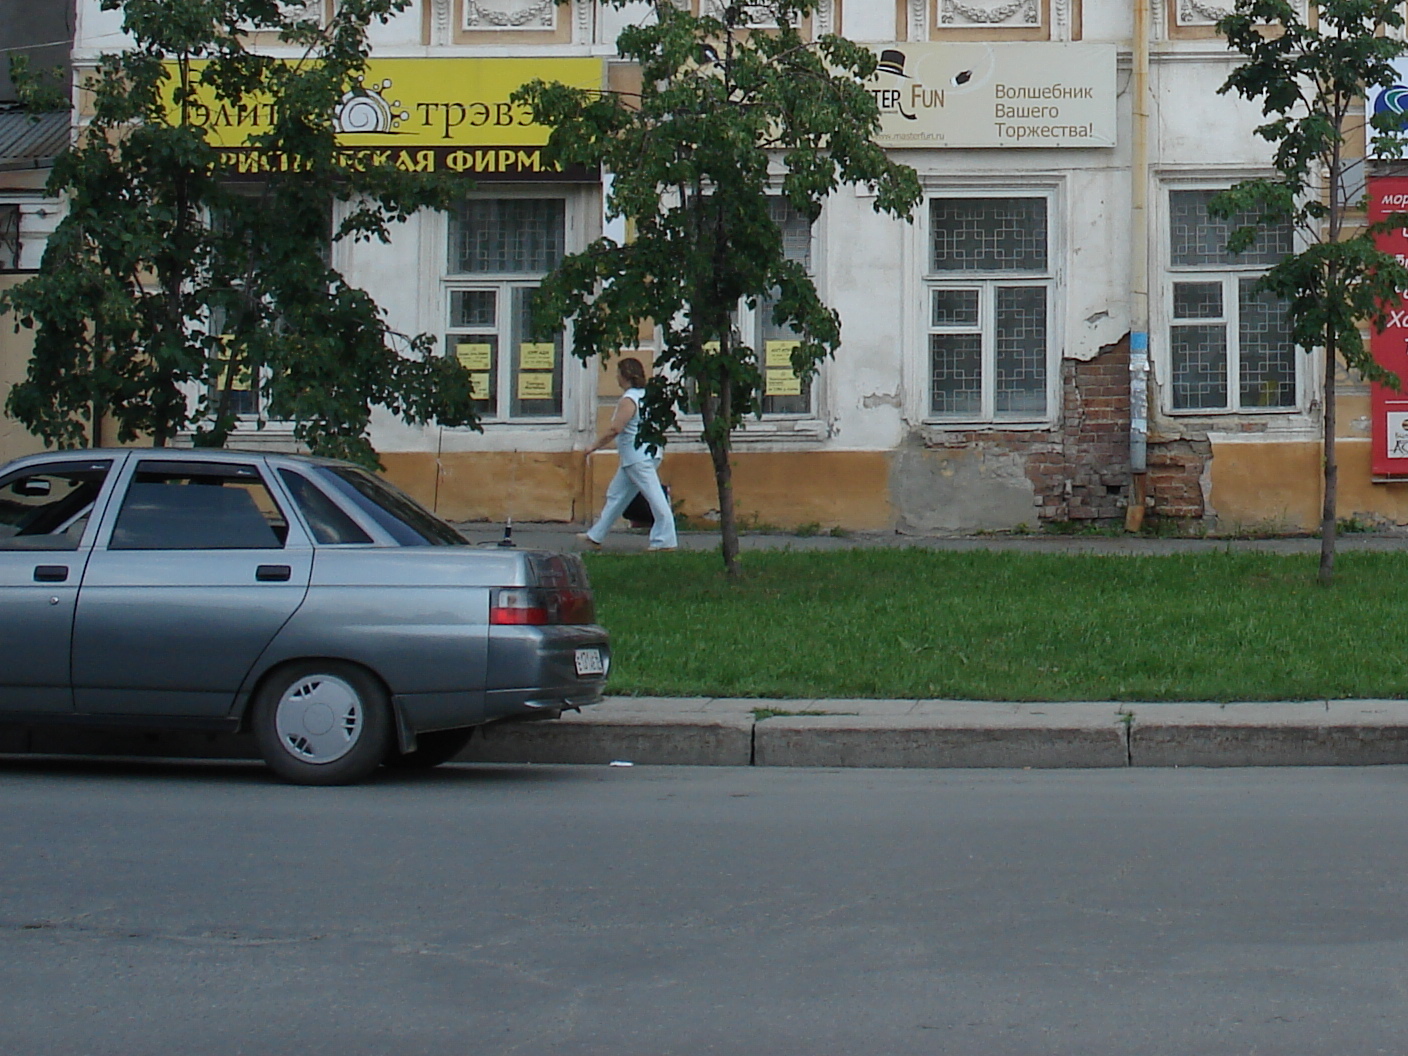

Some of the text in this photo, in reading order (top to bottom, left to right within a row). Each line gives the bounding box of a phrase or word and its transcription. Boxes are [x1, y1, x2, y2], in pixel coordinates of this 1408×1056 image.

[995, 84, 1093, 99] Волшебник
[995, 104, 1059, 118] Вашего
[995, 122, 1093, 141] Торжества!
